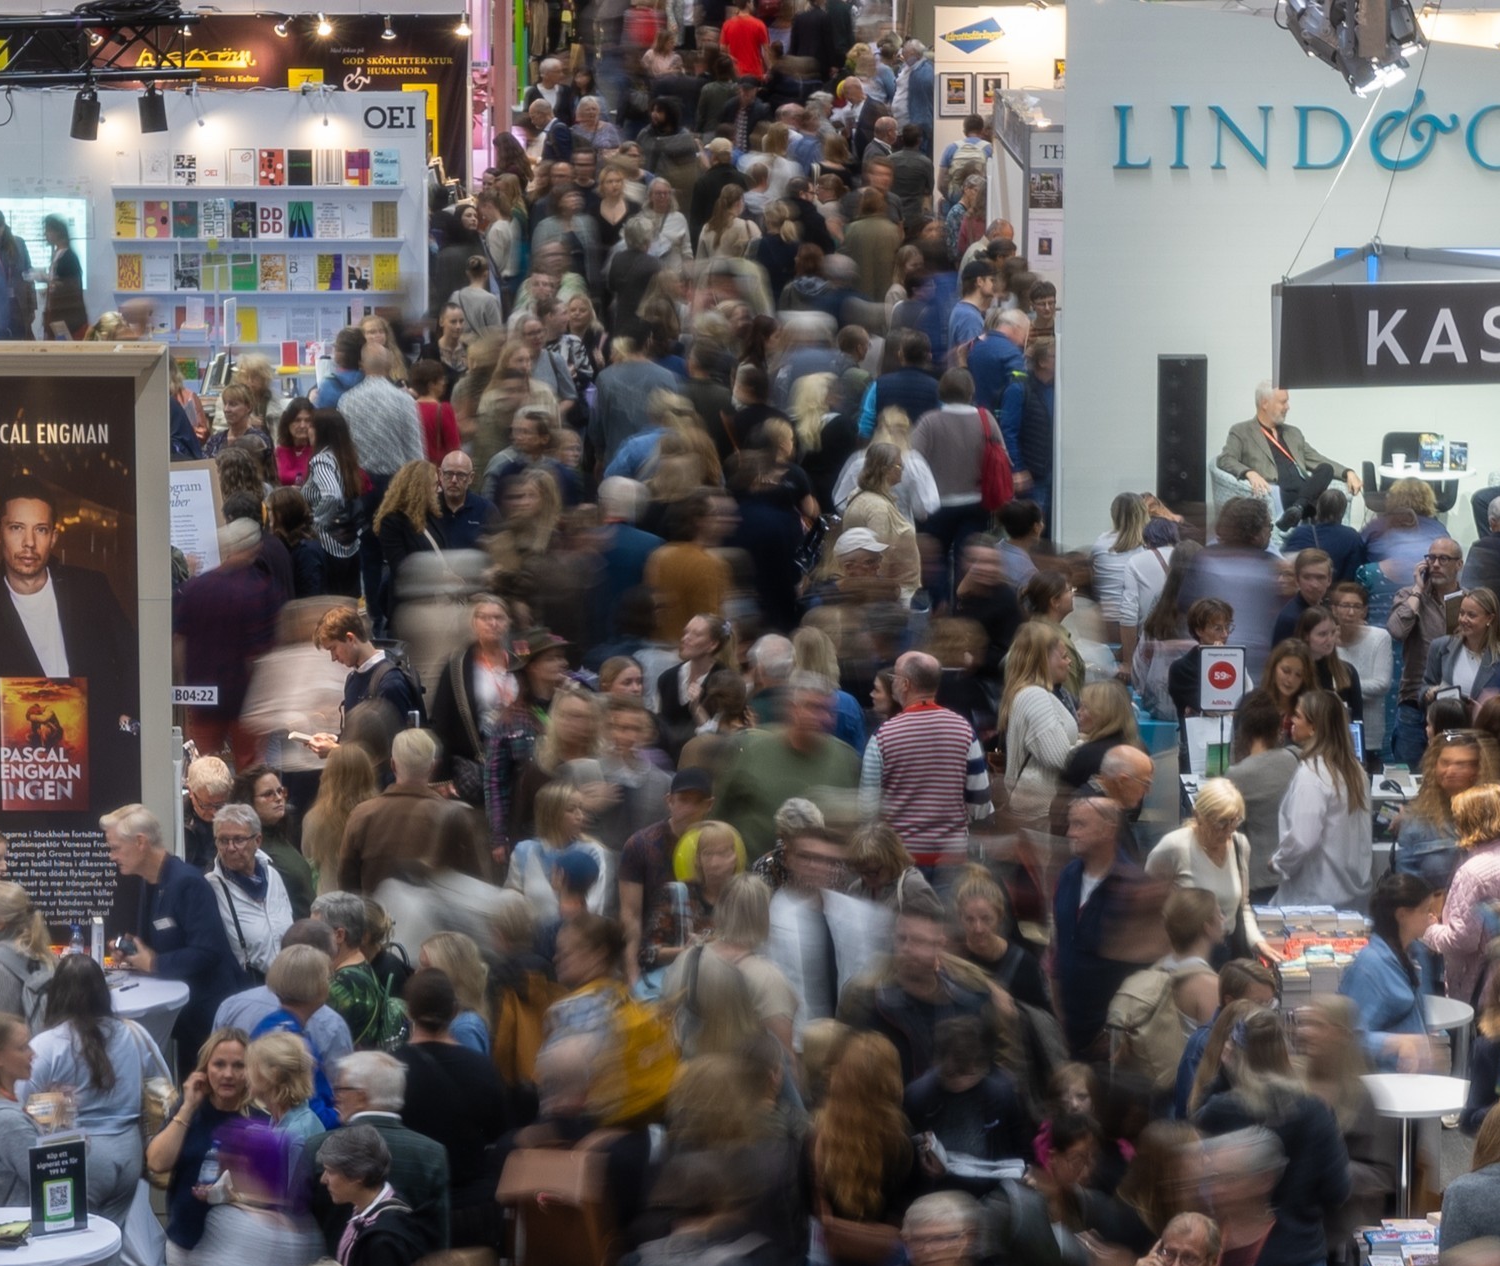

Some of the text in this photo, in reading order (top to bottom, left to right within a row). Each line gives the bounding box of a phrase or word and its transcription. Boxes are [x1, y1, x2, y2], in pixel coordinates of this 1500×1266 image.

[342, 55, 454, 65] GOD SKÖNLITTERATUR
[367, 67, 427, 75] HUMANIORA
[364, 106, 416, 129] OEI
[36, 423, 110, 445] ENGMAN
[174, 690, 214, 703] B04:22
[1, 747, 69, 763] PASCAL
[1, 764, 81, 780] ENGMAN
[2, 781, 73, 800] INGEN
[34, 830, 104, 839] Stockholm fortsätter
[12, 841, 91, 849] polisinspektör Vanessa
